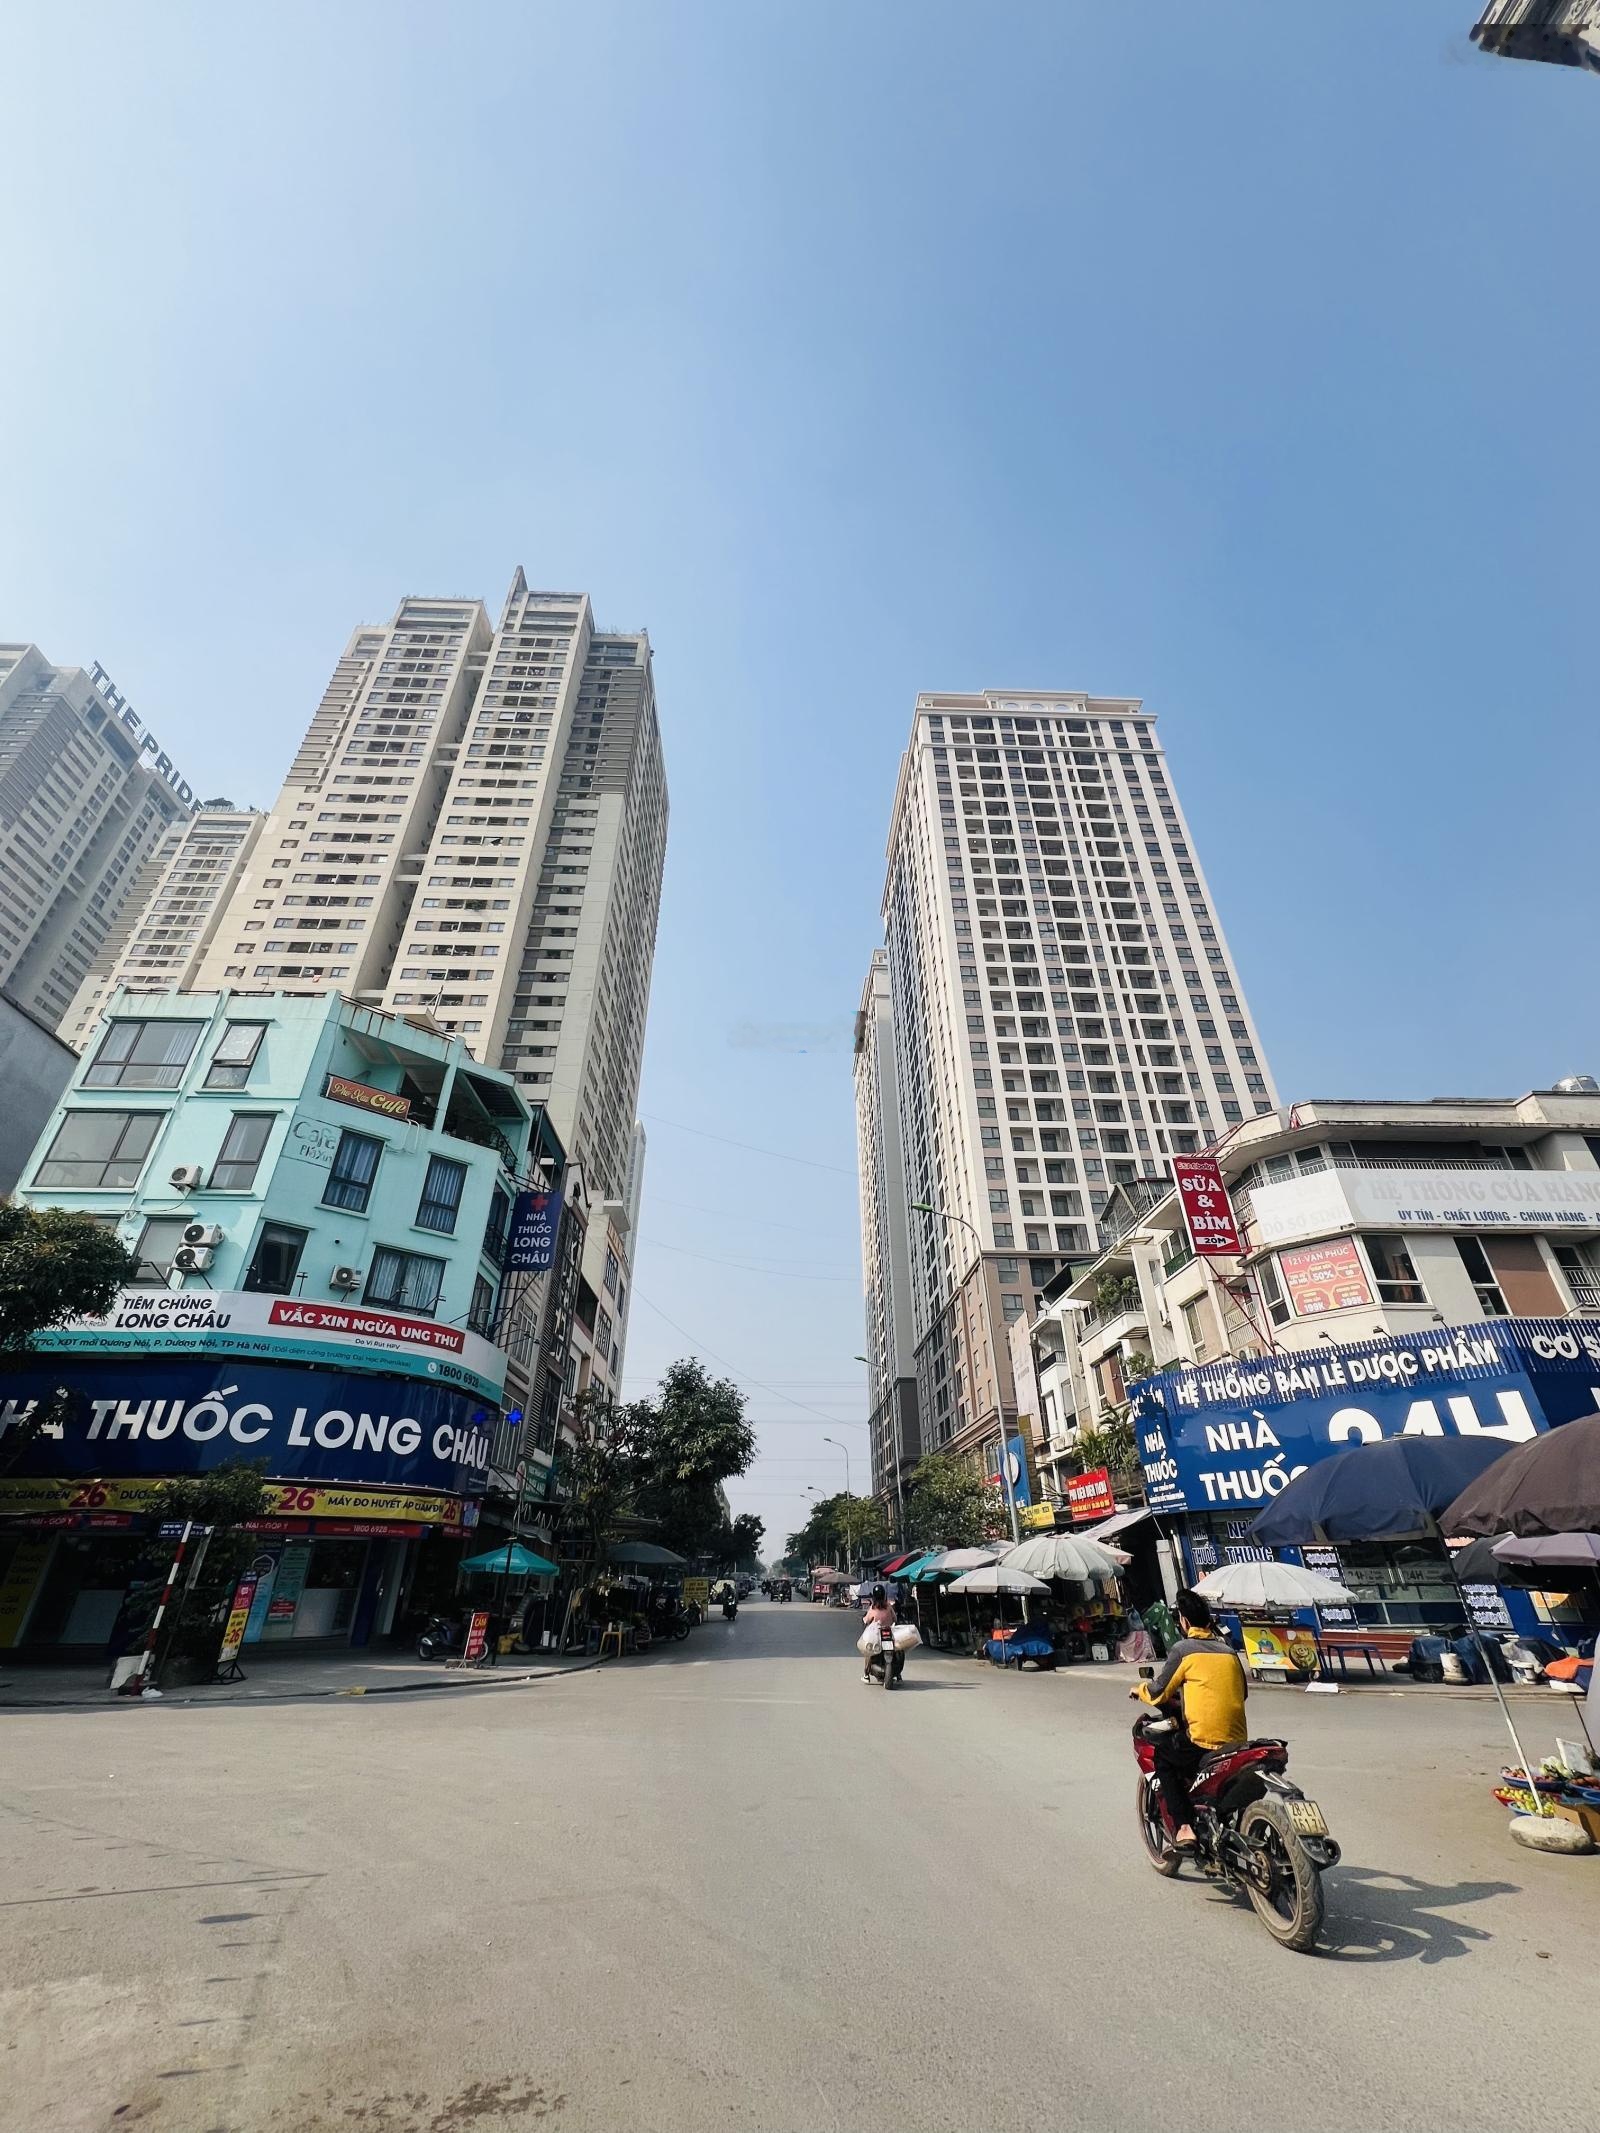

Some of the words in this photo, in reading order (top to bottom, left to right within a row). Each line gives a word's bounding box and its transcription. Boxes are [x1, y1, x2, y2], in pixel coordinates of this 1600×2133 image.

[91, 660, 142, 735] THE
[1182, 1175, 1221, 1191] SỮA
[1198, 1195, 1215, 1207] &
[526, 1211, 547, 1221] NHÀ
[1191, 1211, 1231, 1230] BỈM
[1398, 1210, 1412, 1221] UY
[1414, 1209, 1434, 1221] TÍN
[1443, 1207, 1472, 1222] CHẤT
[1473, 1210, 1511, 1223] LƯỢNG
[1519, 1209, 1553, 1222] CHÍNH
[518, 1222, 552, 1234] THUỐC
[513, 1237, 551, 1248] LONG
[510, 1250, 550, 1264] CHÂU
[1313, 1270, 1334, 1281] 50%
[123, 1296, 153, 1310] TIÊM
[158, 1294, 212, 1310] CHỦNG
[115, 1313, 173, 1328] LONG
[176, 1309, 231, 1328] CHÂU
[279, 1306, 315, 1324] VẮC
[318, 1313, 349, 1329] XIN
[351, 1315, 397, 1336] NGỪA
[400, 1326, 432, 1342] UNG
[433, 1332, 460, 1349] THƯ
[221, 1340, 235, 1348] TP
[1532, 1331, 1579, 1359] CƠ
[438, 1362, 462, 1381] 1800
[463, 1371, 480, 1388] 6928
[1175, 1379, 1201, 1408] HỆ
[1202, 1368, 1271, 1401] THỐNG
[1274, 1365, 1320, 1397] BÁN
[1321, 1354, 1348, 1387] LẺ
[1347, 1350, 1418, 1384] DƯỢC
[1421, 1330, 1499, 1373] PHẨM
[86, 1384, 273, 1444] THUỐC
[287, 1407, 422, 1455] LONG
[432, 1425, 489, 1470] CHÂU
[1205, 1410, 1280, 1452] NHÀ
[1144, 1424, 1166, 1453] NHÀ
[1144, 1450, 1178, 1483] THUỐC
[328, 1492, 352, 1507] MÁY
[353, 1497, 370, 1508] ĐO
